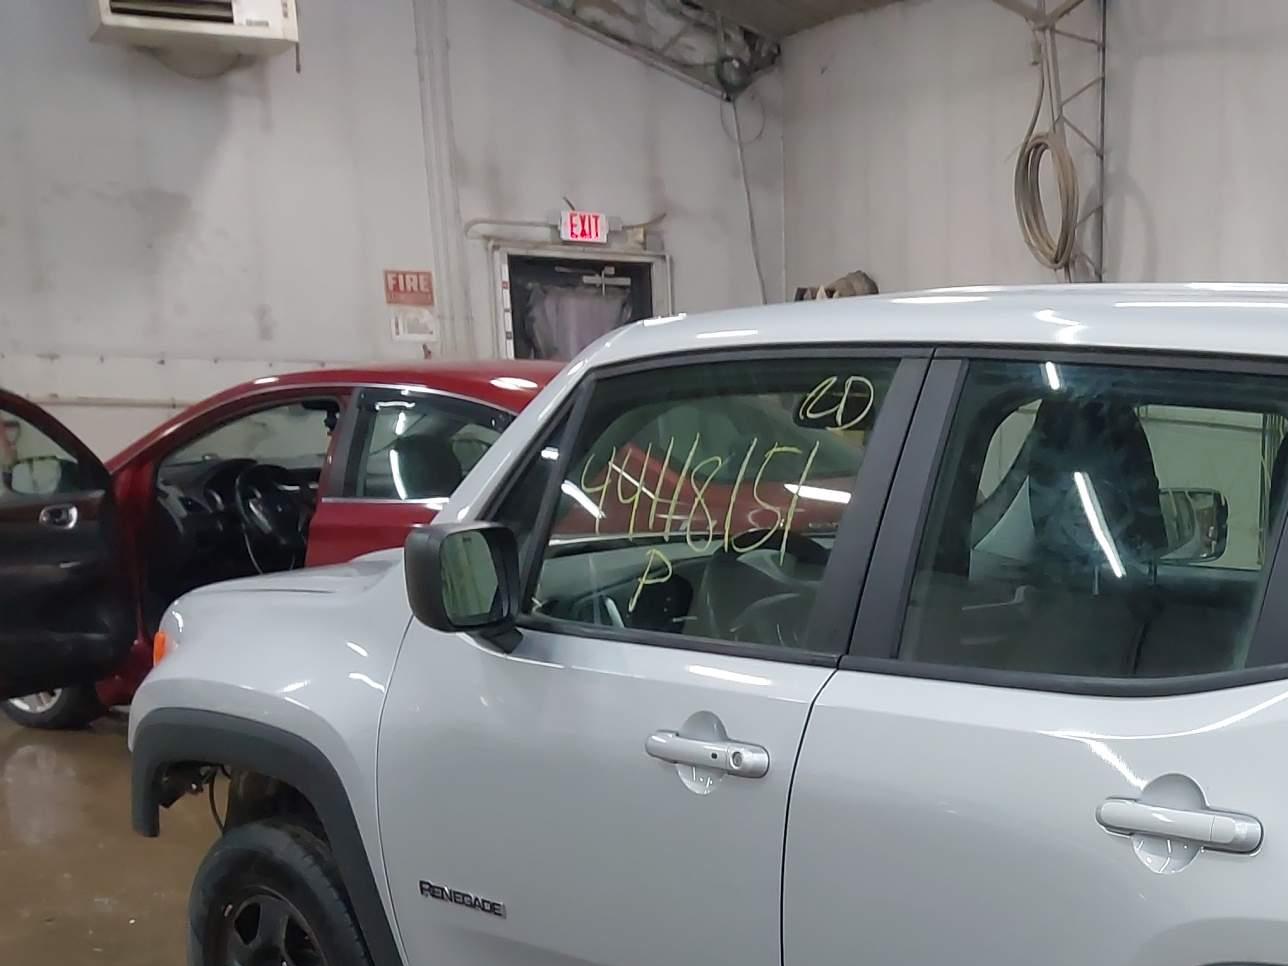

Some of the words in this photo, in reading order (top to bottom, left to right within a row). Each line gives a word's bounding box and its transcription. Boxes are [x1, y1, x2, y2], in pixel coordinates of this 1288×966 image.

[569, 212, 600, 239] EXIT
[386, 272, 431, 292] FIRE
[580, 432, 820, 566] 44118151
[418, 879, 506, 918] RENEGADE
